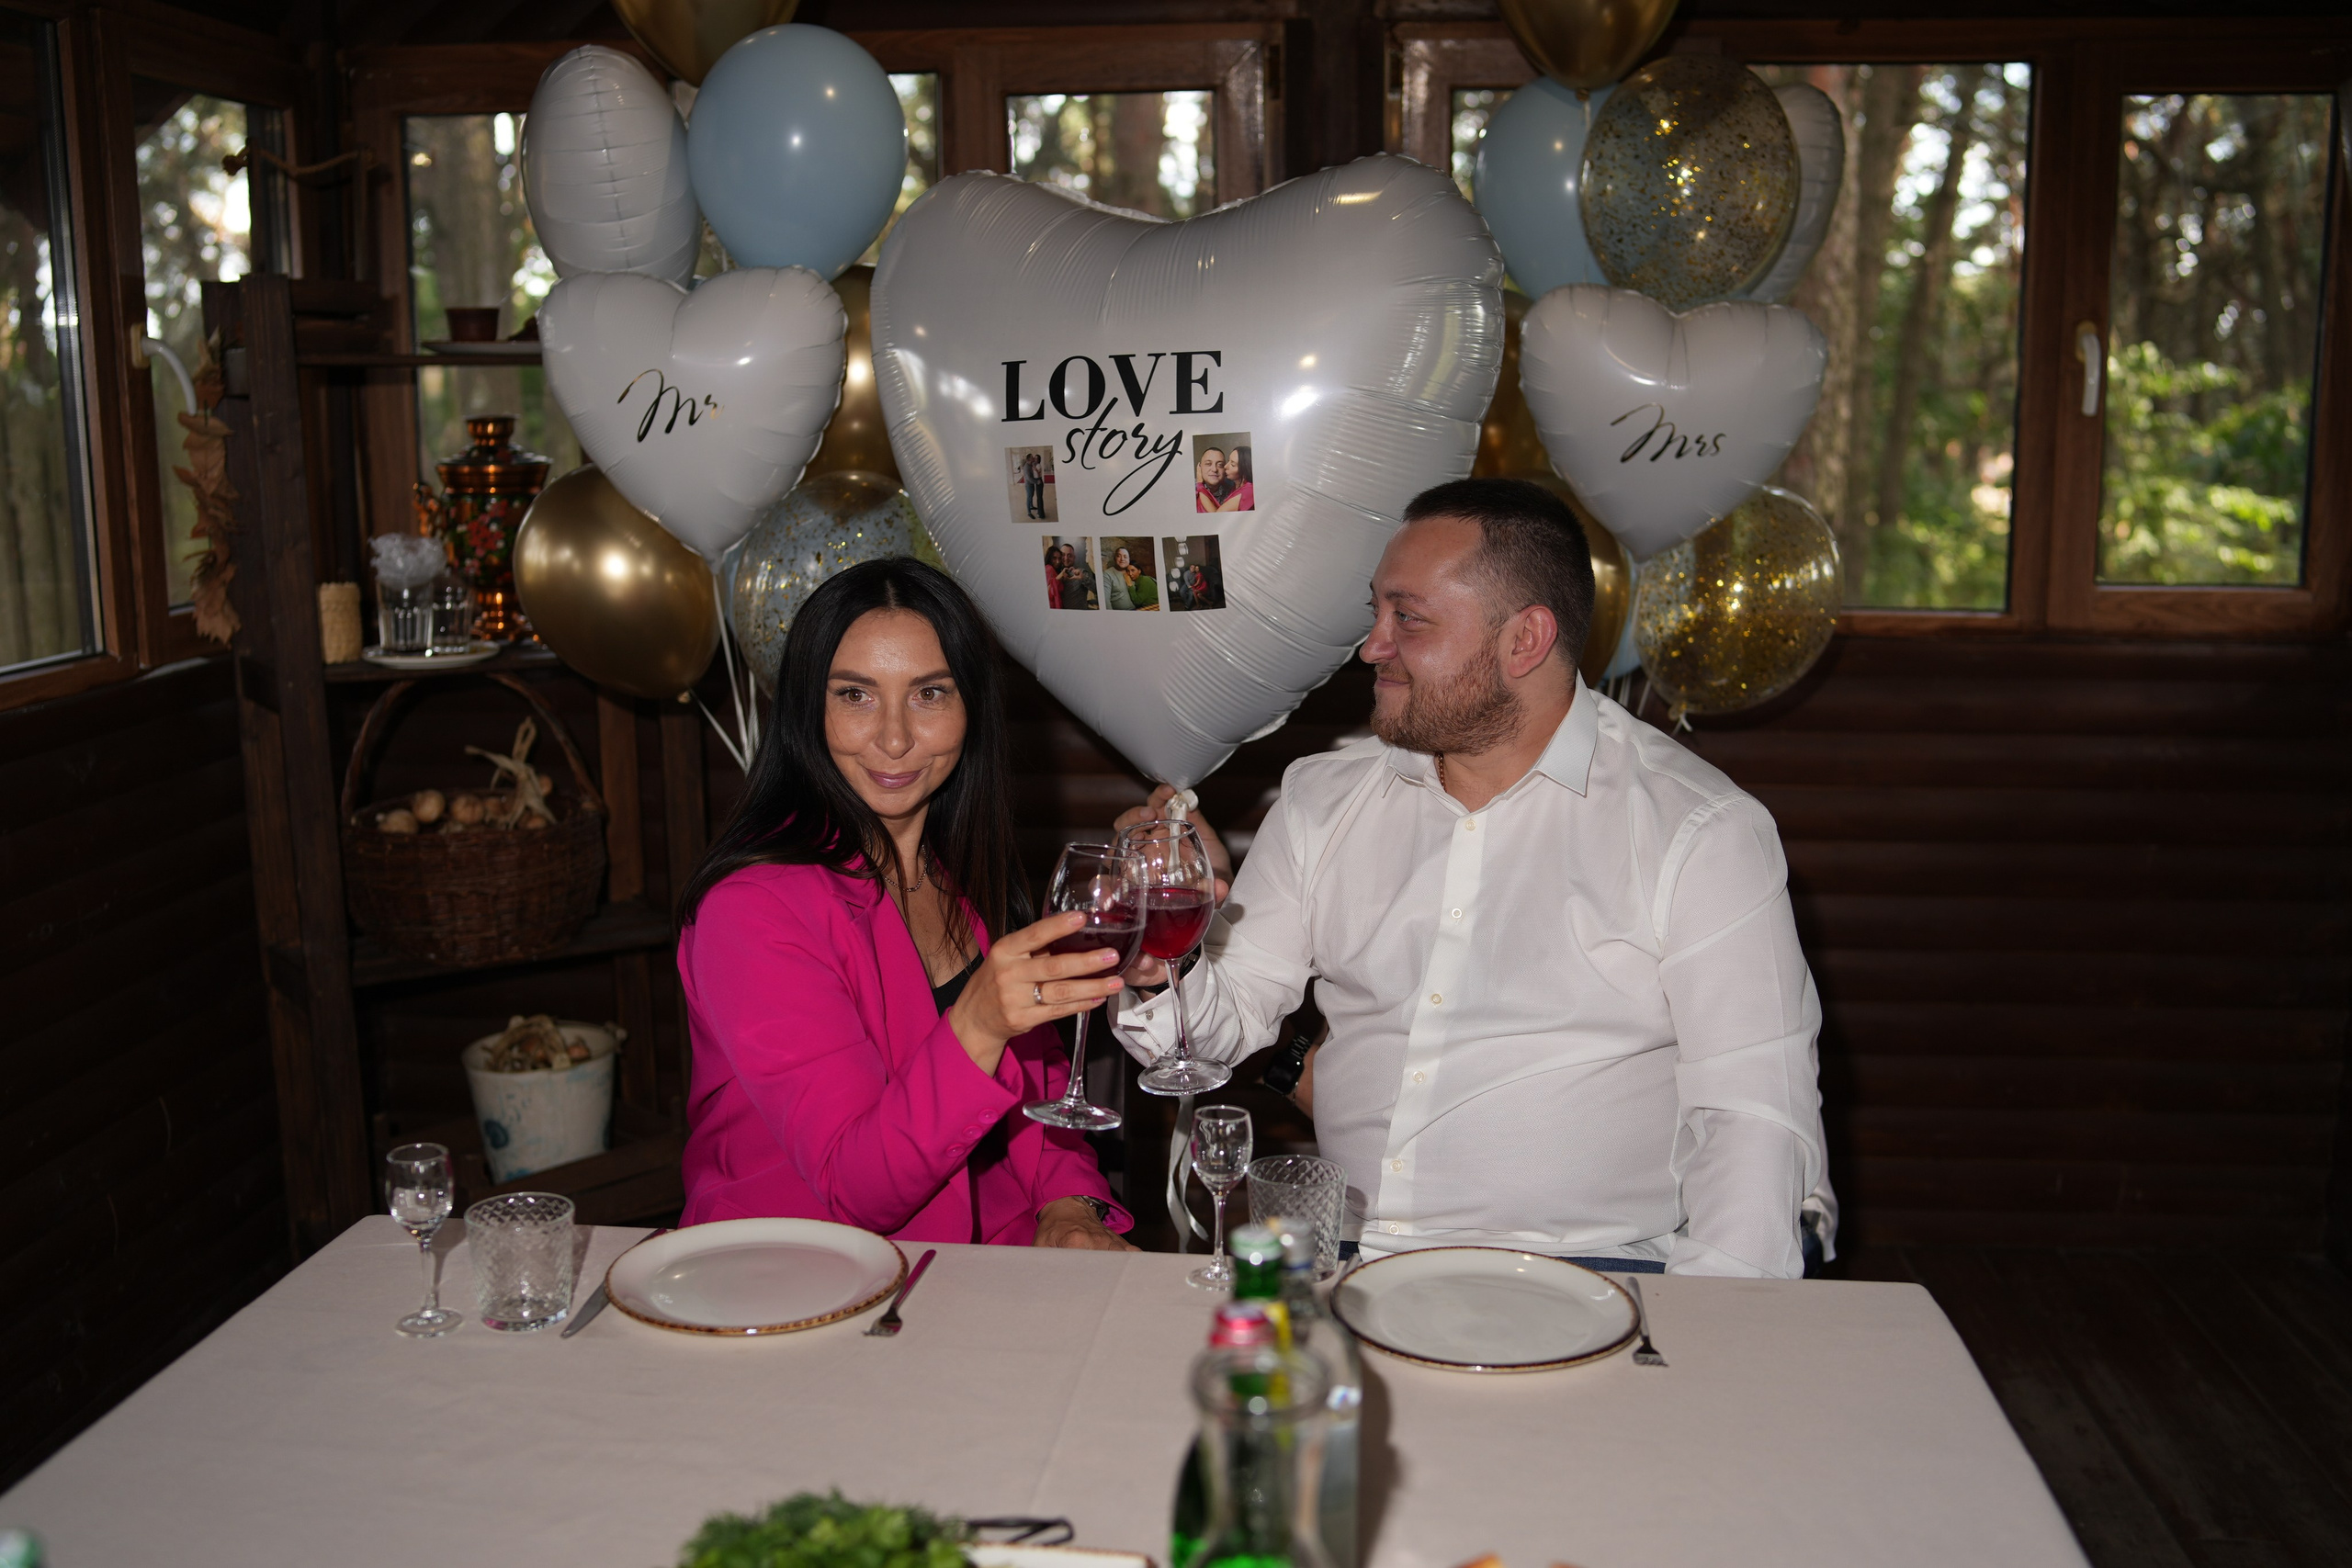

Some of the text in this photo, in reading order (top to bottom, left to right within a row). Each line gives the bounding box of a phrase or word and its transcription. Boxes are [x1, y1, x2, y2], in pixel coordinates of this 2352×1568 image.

[616, 368, 725, 443] Mr
[1001, 350, 1224, 423] LOVE
[1061, 397, 1183, 516] story
[1610, 401, 1727, 463] Mrs
